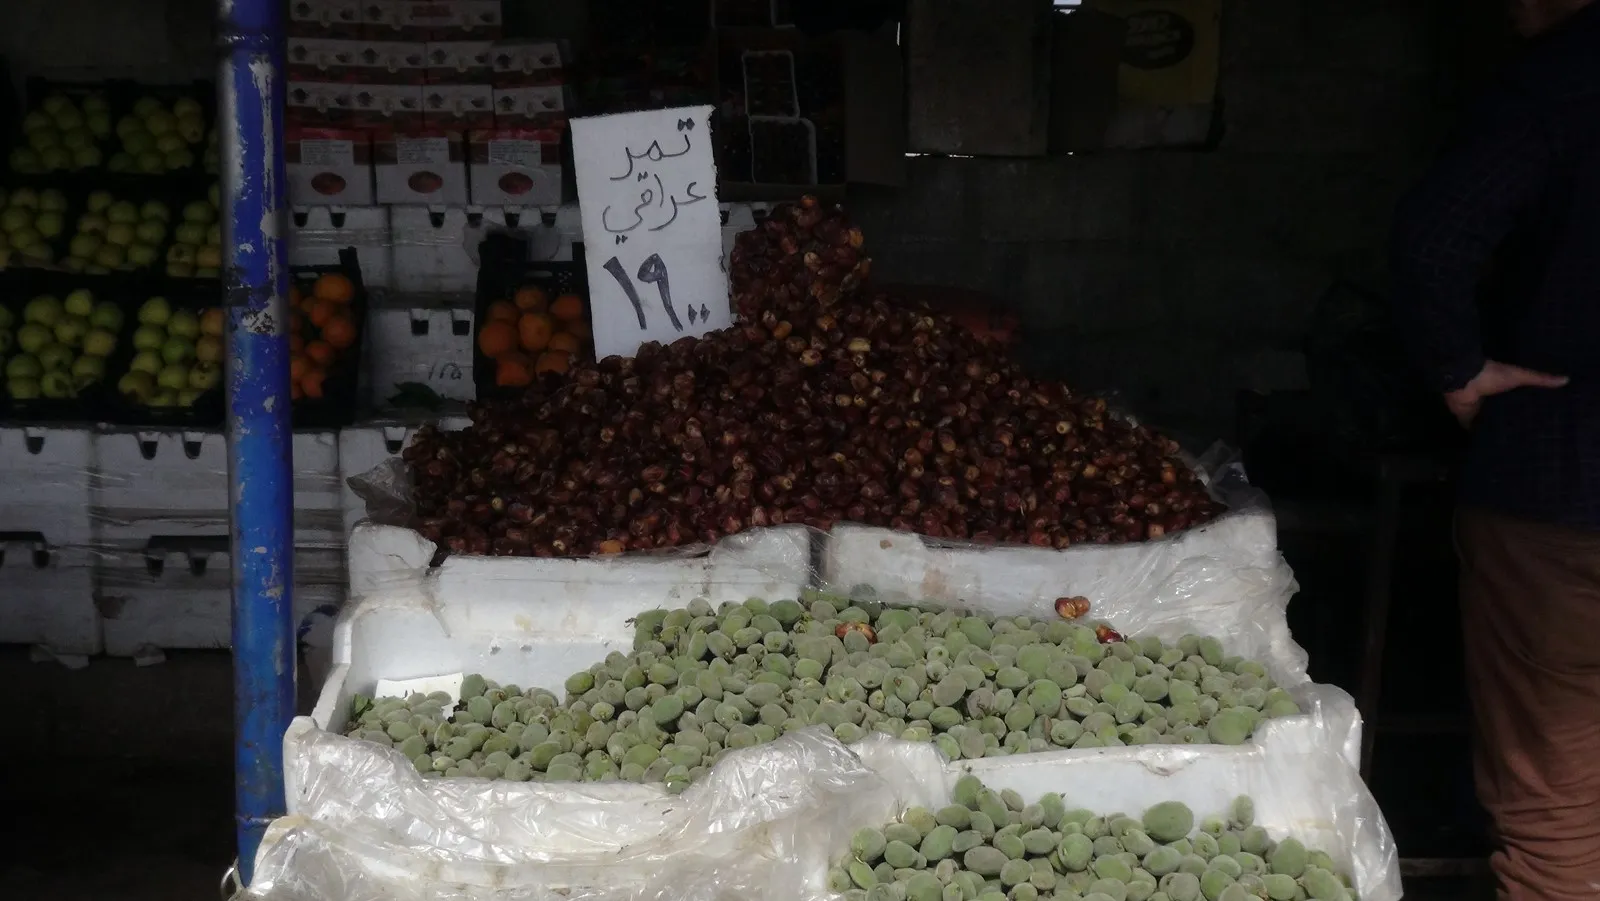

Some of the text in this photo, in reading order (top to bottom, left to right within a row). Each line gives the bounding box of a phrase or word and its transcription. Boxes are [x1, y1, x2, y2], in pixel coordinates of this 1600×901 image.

[610, 117, 695, 181] تمر
[602, 172, 706, 244] عراقي
[603, 253, 710, 332] ١٩٠٠
